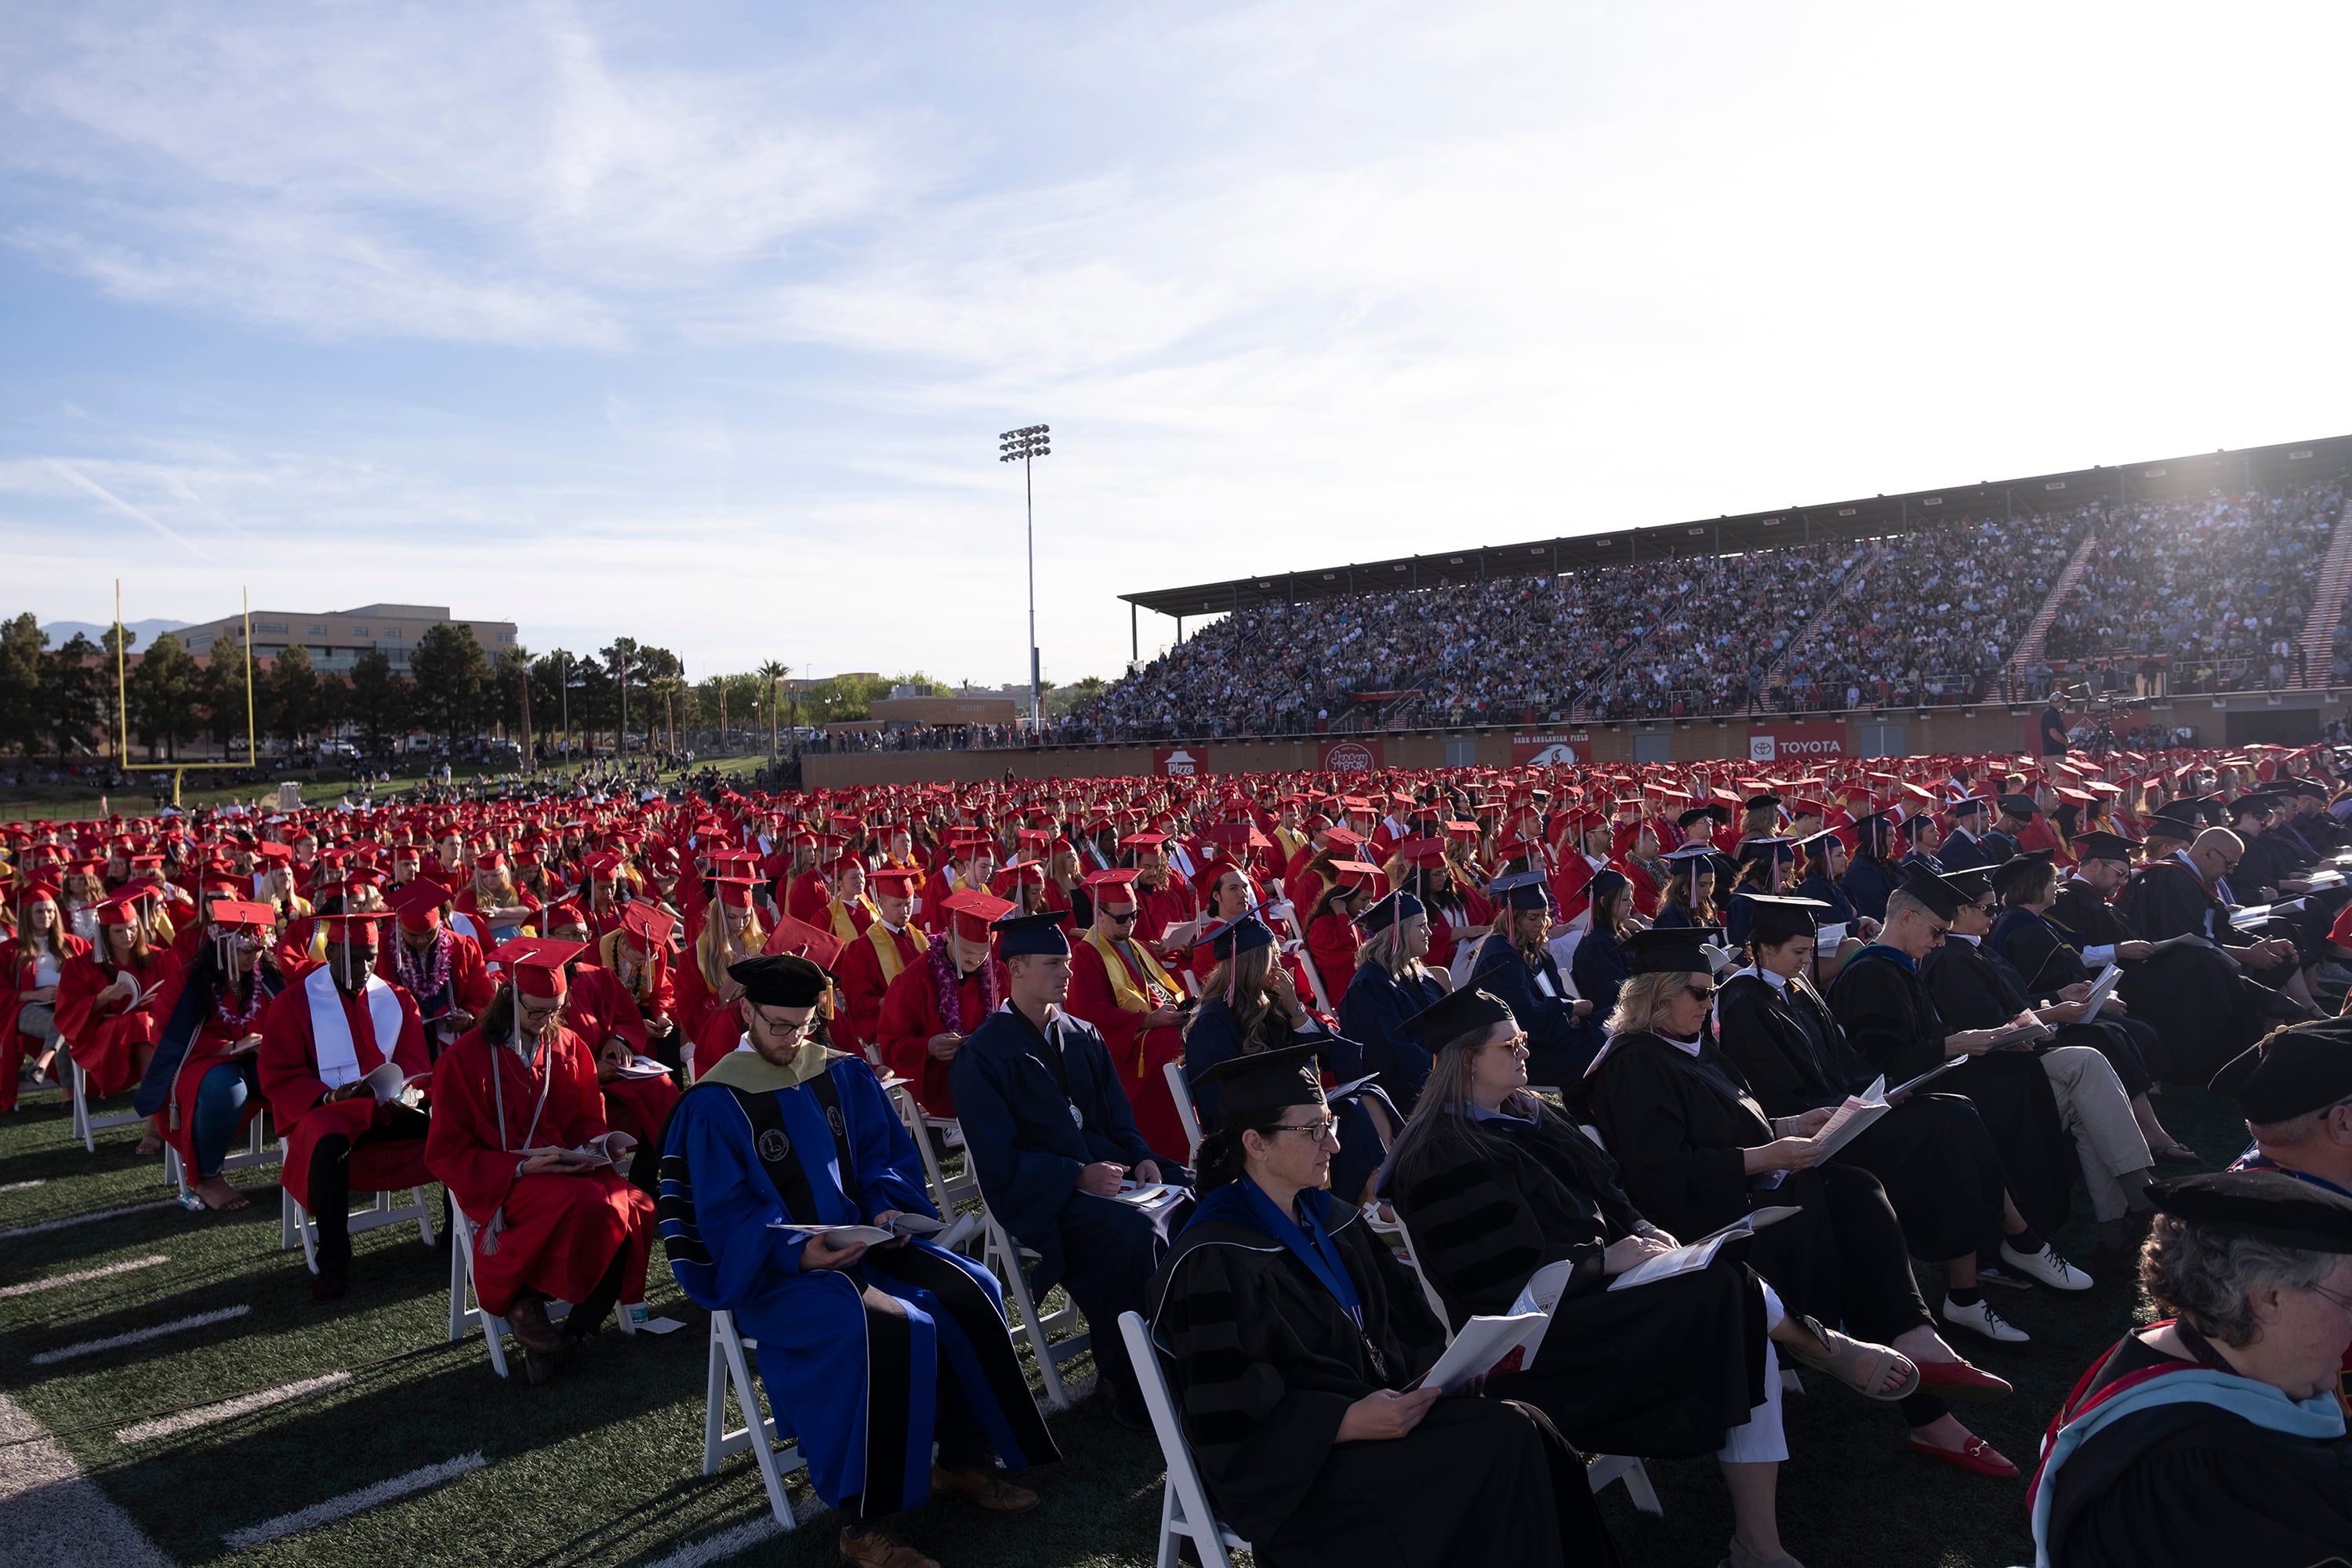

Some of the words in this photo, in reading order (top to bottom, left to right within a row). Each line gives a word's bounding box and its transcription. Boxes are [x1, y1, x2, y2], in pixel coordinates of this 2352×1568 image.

[1780, 741, 1841, 753] TOYOTA
[1331, 750, 1367, 766] Jersey
[1168, 763, 1194, 775] Pizza
